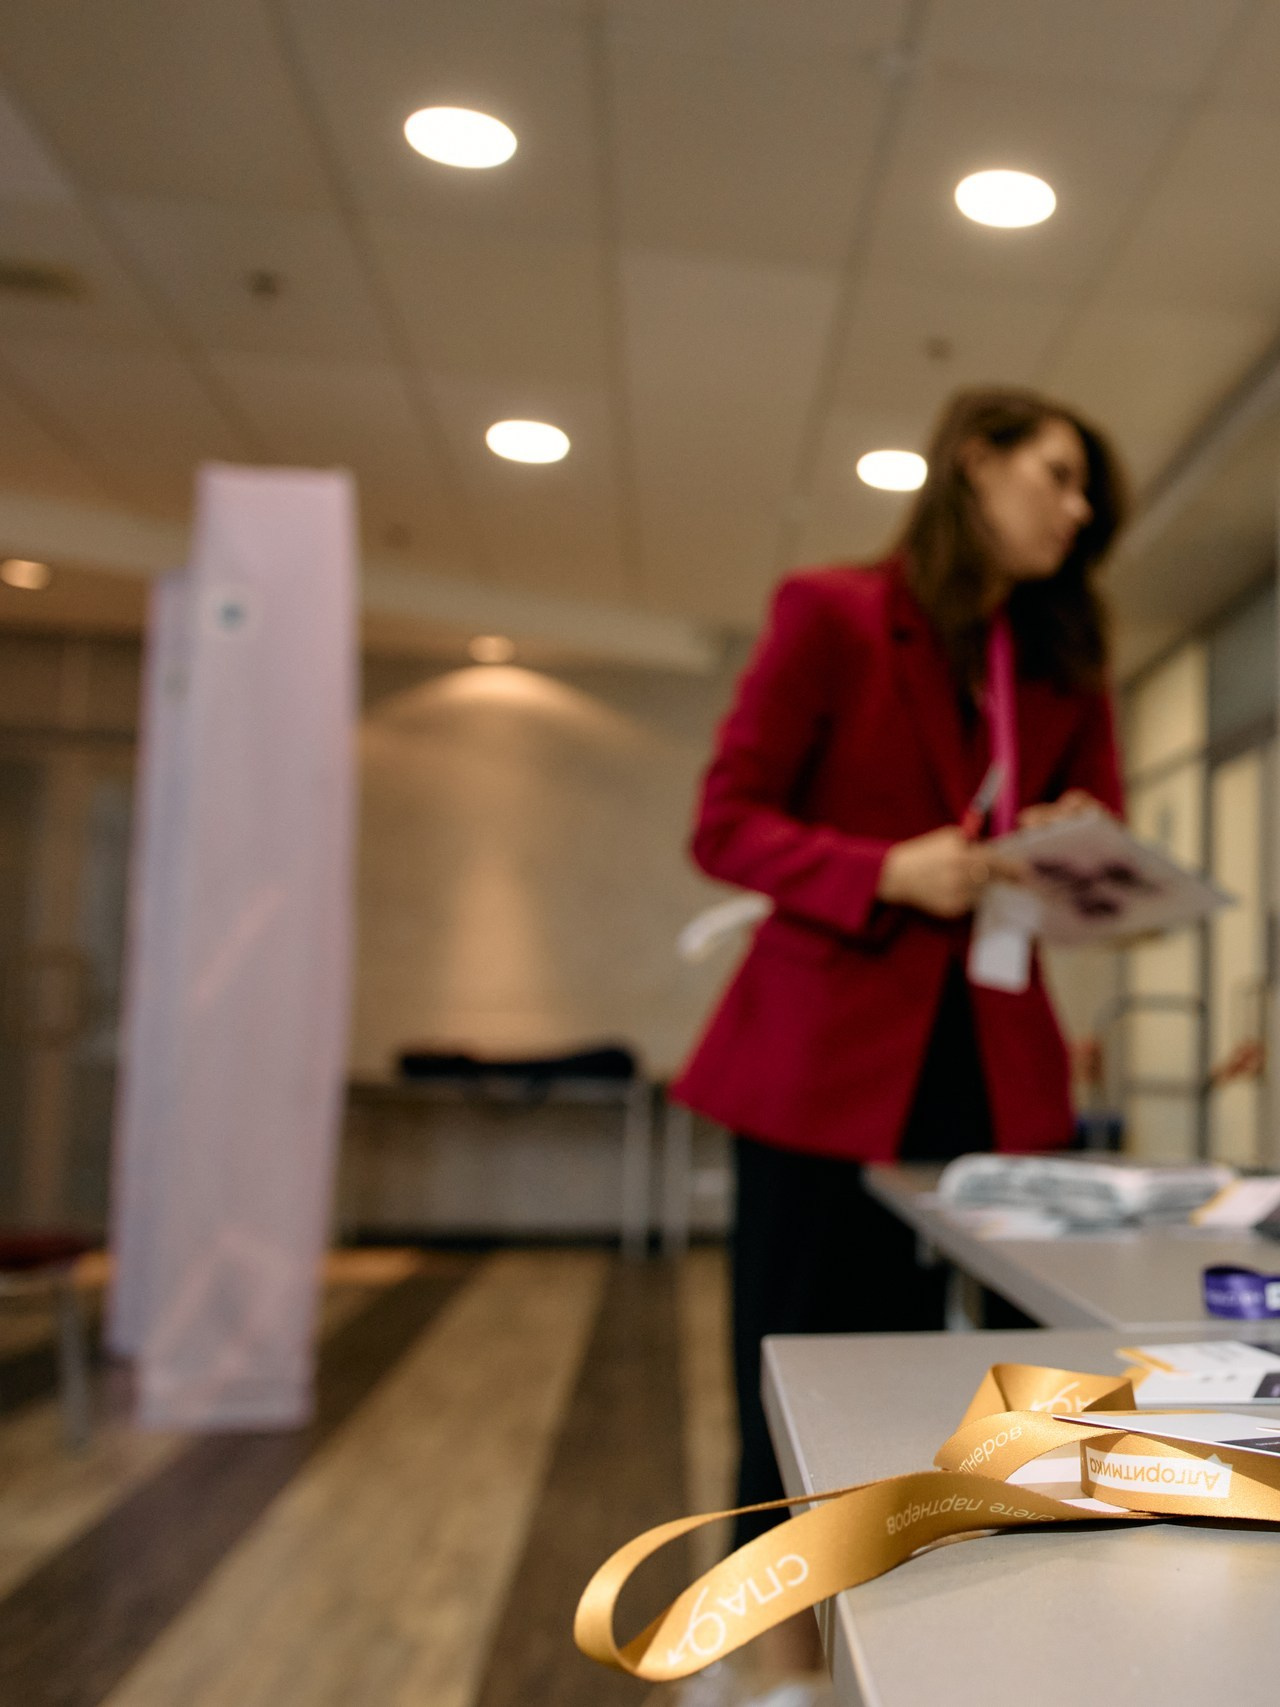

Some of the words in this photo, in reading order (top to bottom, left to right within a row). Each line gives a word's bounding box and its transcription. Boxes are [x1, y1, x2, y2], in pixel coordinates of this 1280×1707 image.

[958, 1425, 1023, 1474] тнеров
[1089, 1456, 1221, 1491] Алгоритмика
[886, 1493, 984, 1536] партнеров
